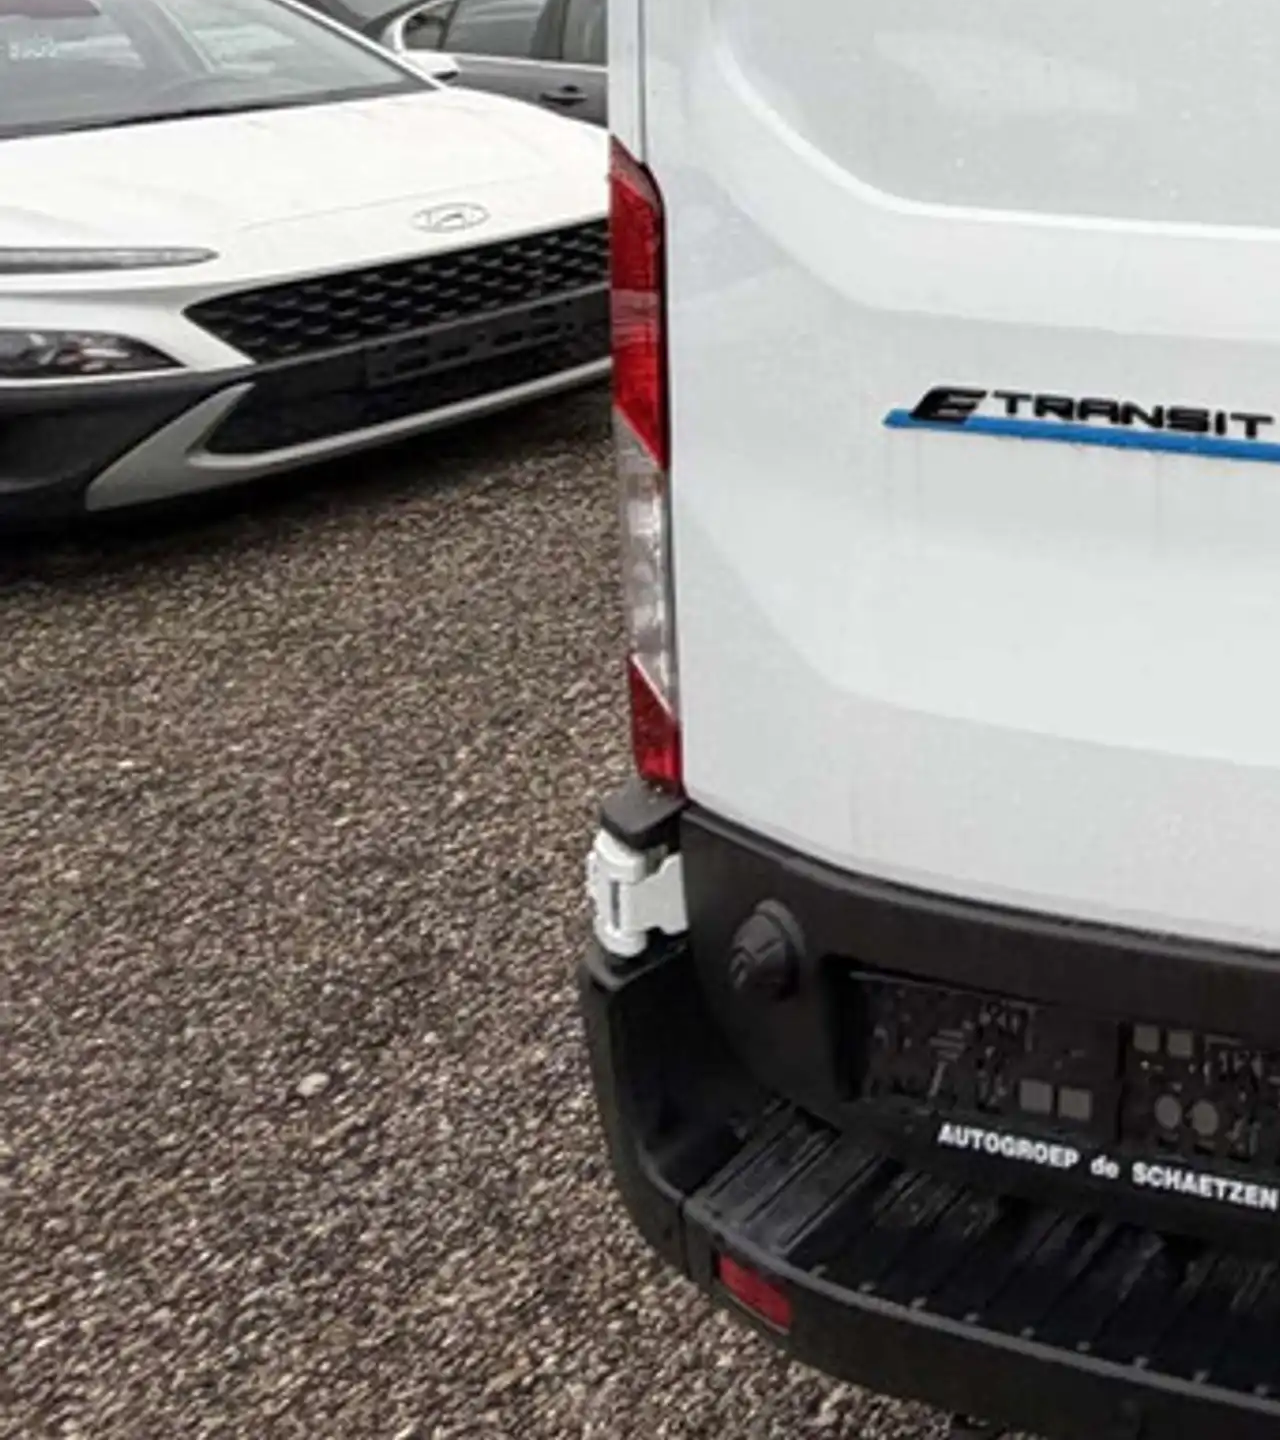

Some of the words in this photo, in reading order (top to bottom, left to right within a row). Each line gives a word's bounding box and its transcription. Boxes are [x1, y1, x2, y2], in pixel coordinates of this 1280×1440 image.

[937, 1121, 1080, 1170] AUTOGROEP
[1090, 1155, 1120, 1180] de
[1131, 1161, 1280, 1210] SCHAETZEN
